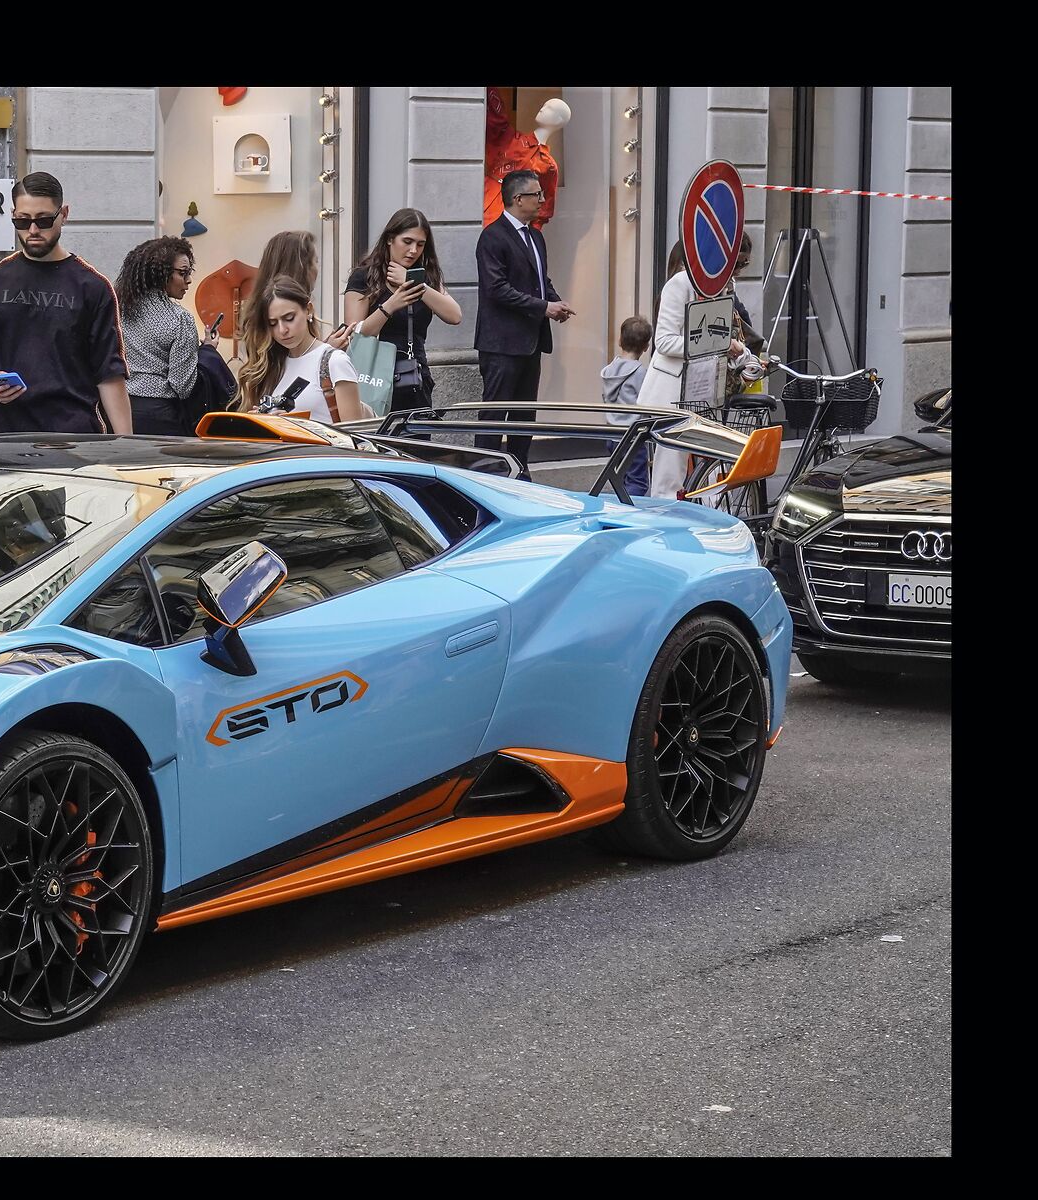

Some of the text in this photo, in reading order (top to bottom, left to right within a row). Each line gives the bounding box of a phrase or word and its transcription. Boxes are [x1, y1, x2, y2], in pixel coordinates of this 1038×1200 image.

[2, 289, 75, 310] LANVIN
[358, 373, 384, 387] BEAR
[226, 680, 350, 740] STO
